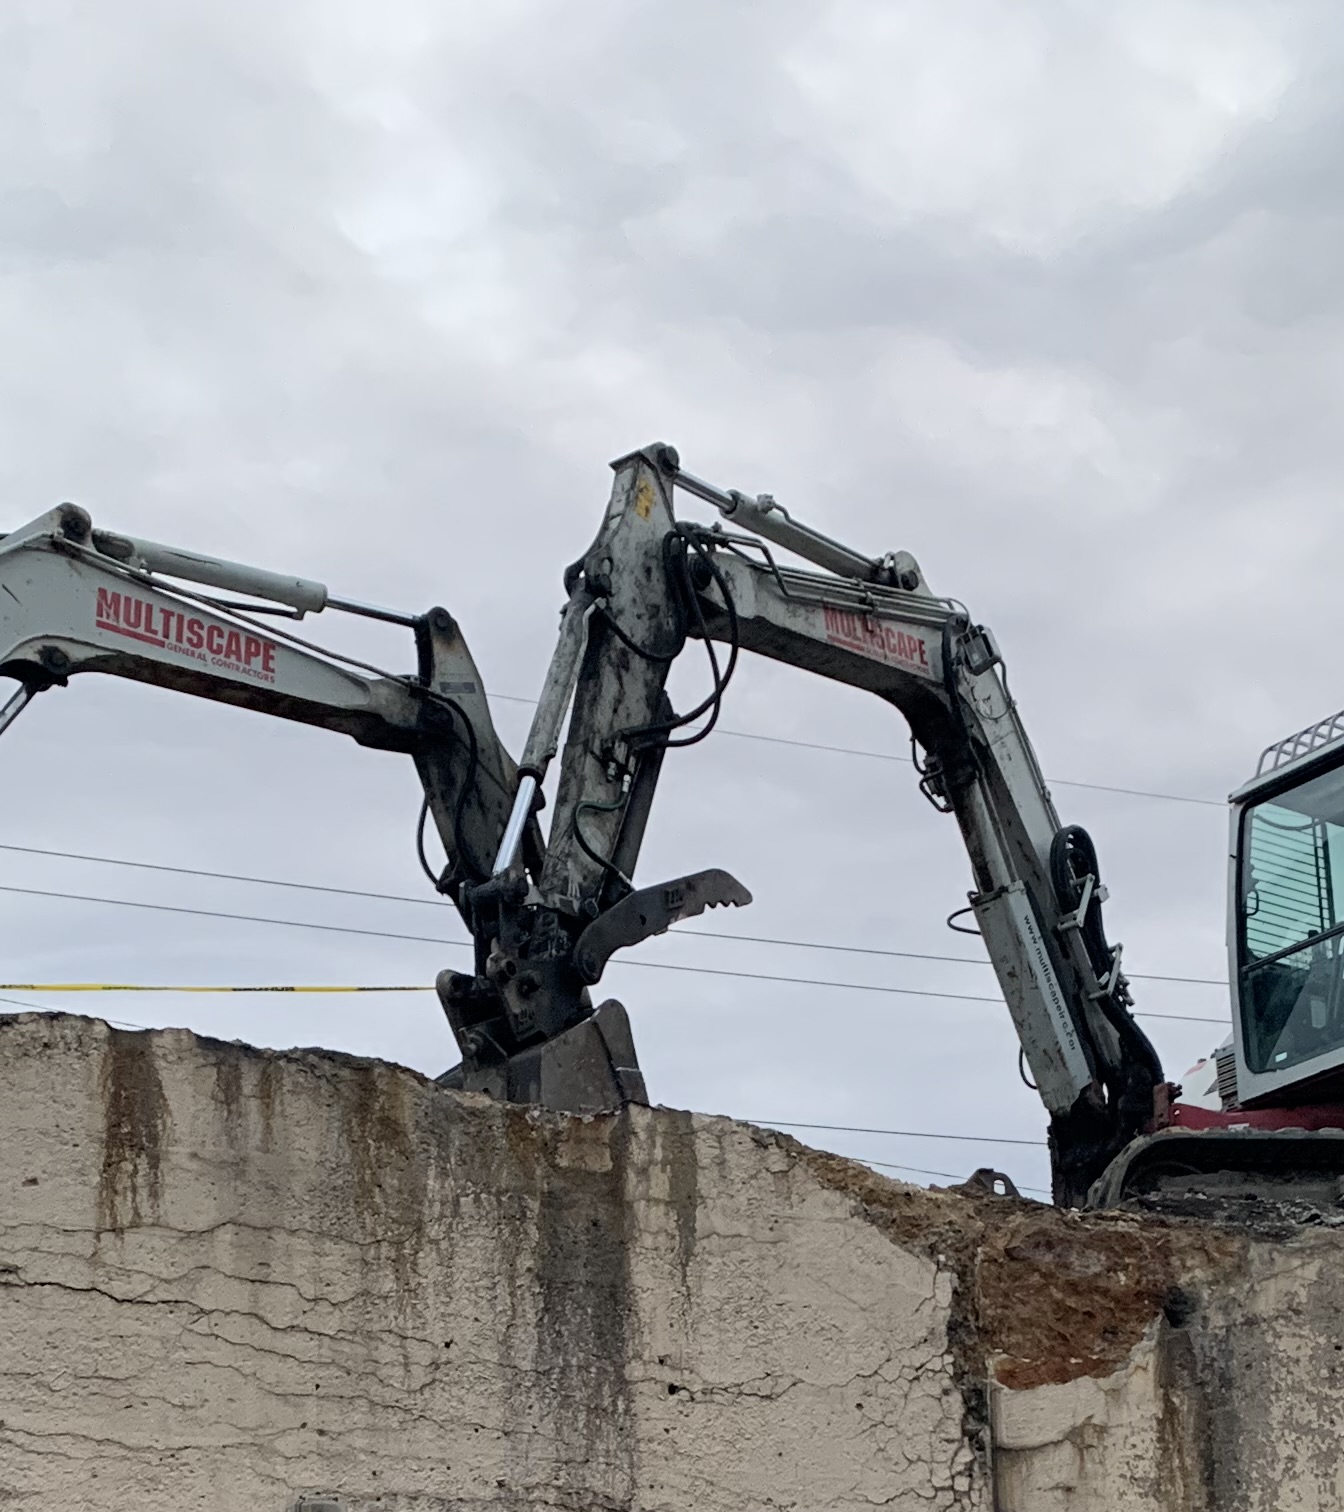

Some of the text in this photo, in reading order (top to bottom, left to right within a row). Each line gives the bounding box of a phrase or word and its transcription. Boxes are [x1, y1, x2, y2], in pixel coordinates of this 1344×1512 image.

[96, 587, 276, 674] MULTISCAPE
[166, 642, 276, 684] GENERAL CONTRACTORS
